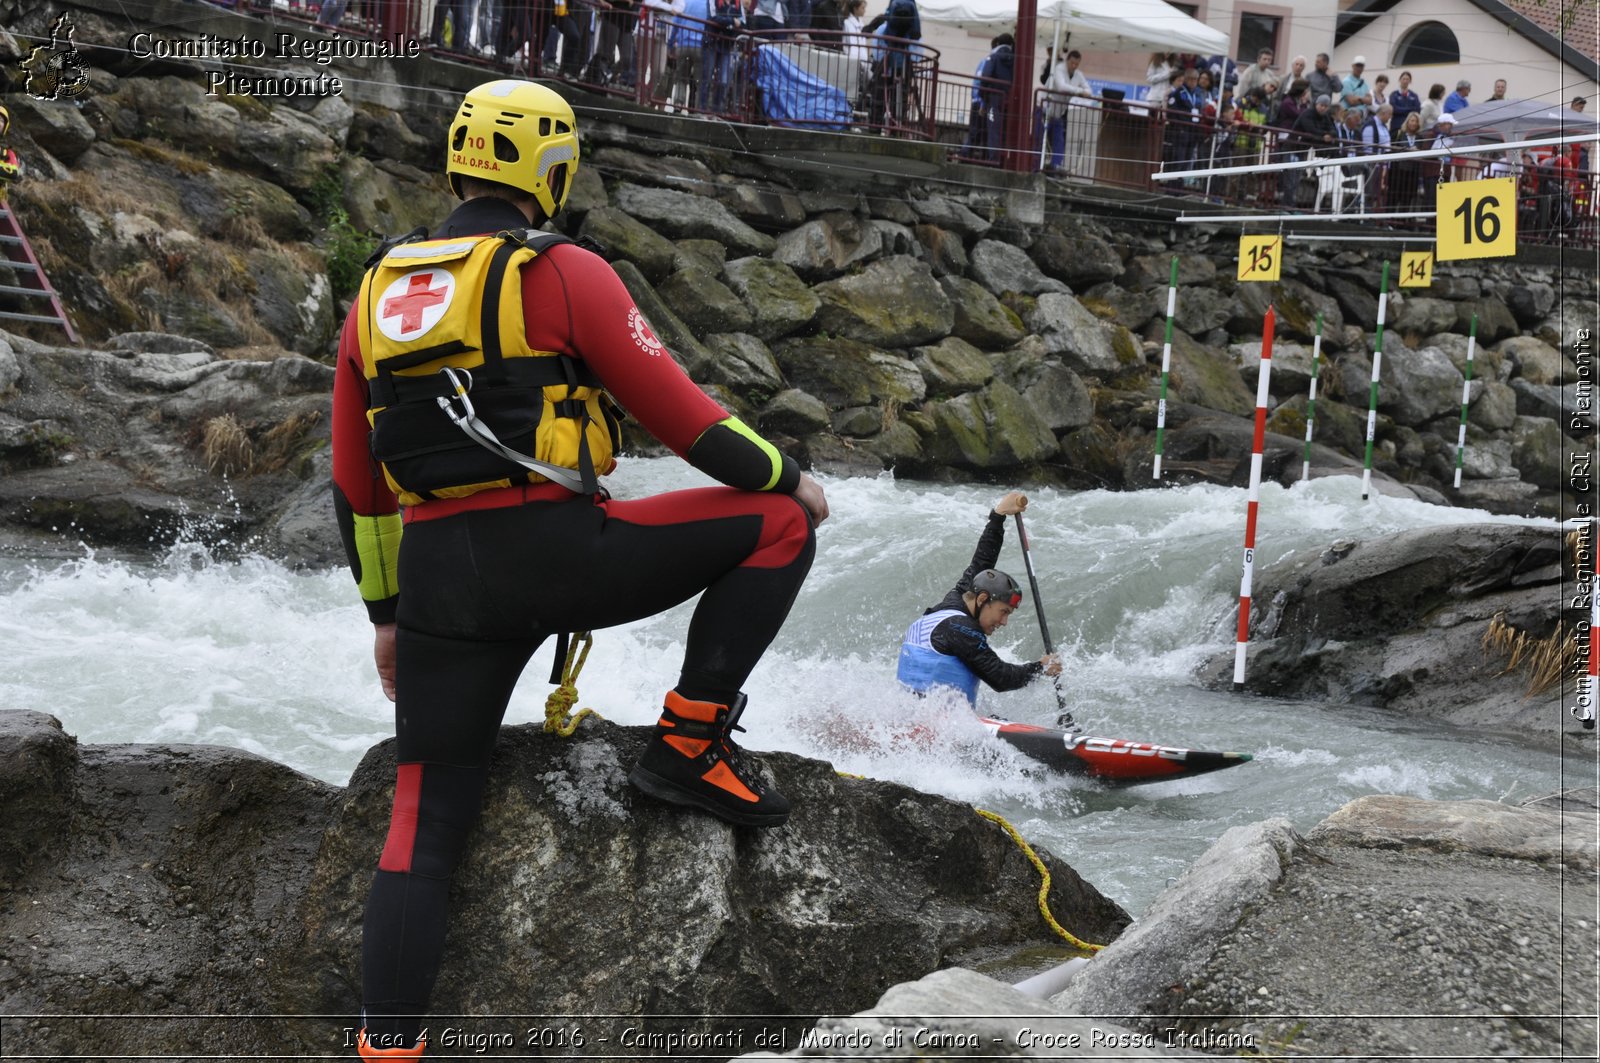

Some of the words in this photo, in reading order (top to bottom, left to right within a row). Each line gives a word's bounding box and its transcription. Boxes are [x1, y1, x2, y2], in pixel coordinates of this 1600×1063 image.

[468, 136, 485, 150] 10
[469, 158, 501, 172] O.P.S.A.
[1454, 195, 1501, 245] 16
[1247, 244, 1272, 272] 15
[1407, 259, 1427, 280] 14
[630, 331, 661, 357] CROCE
